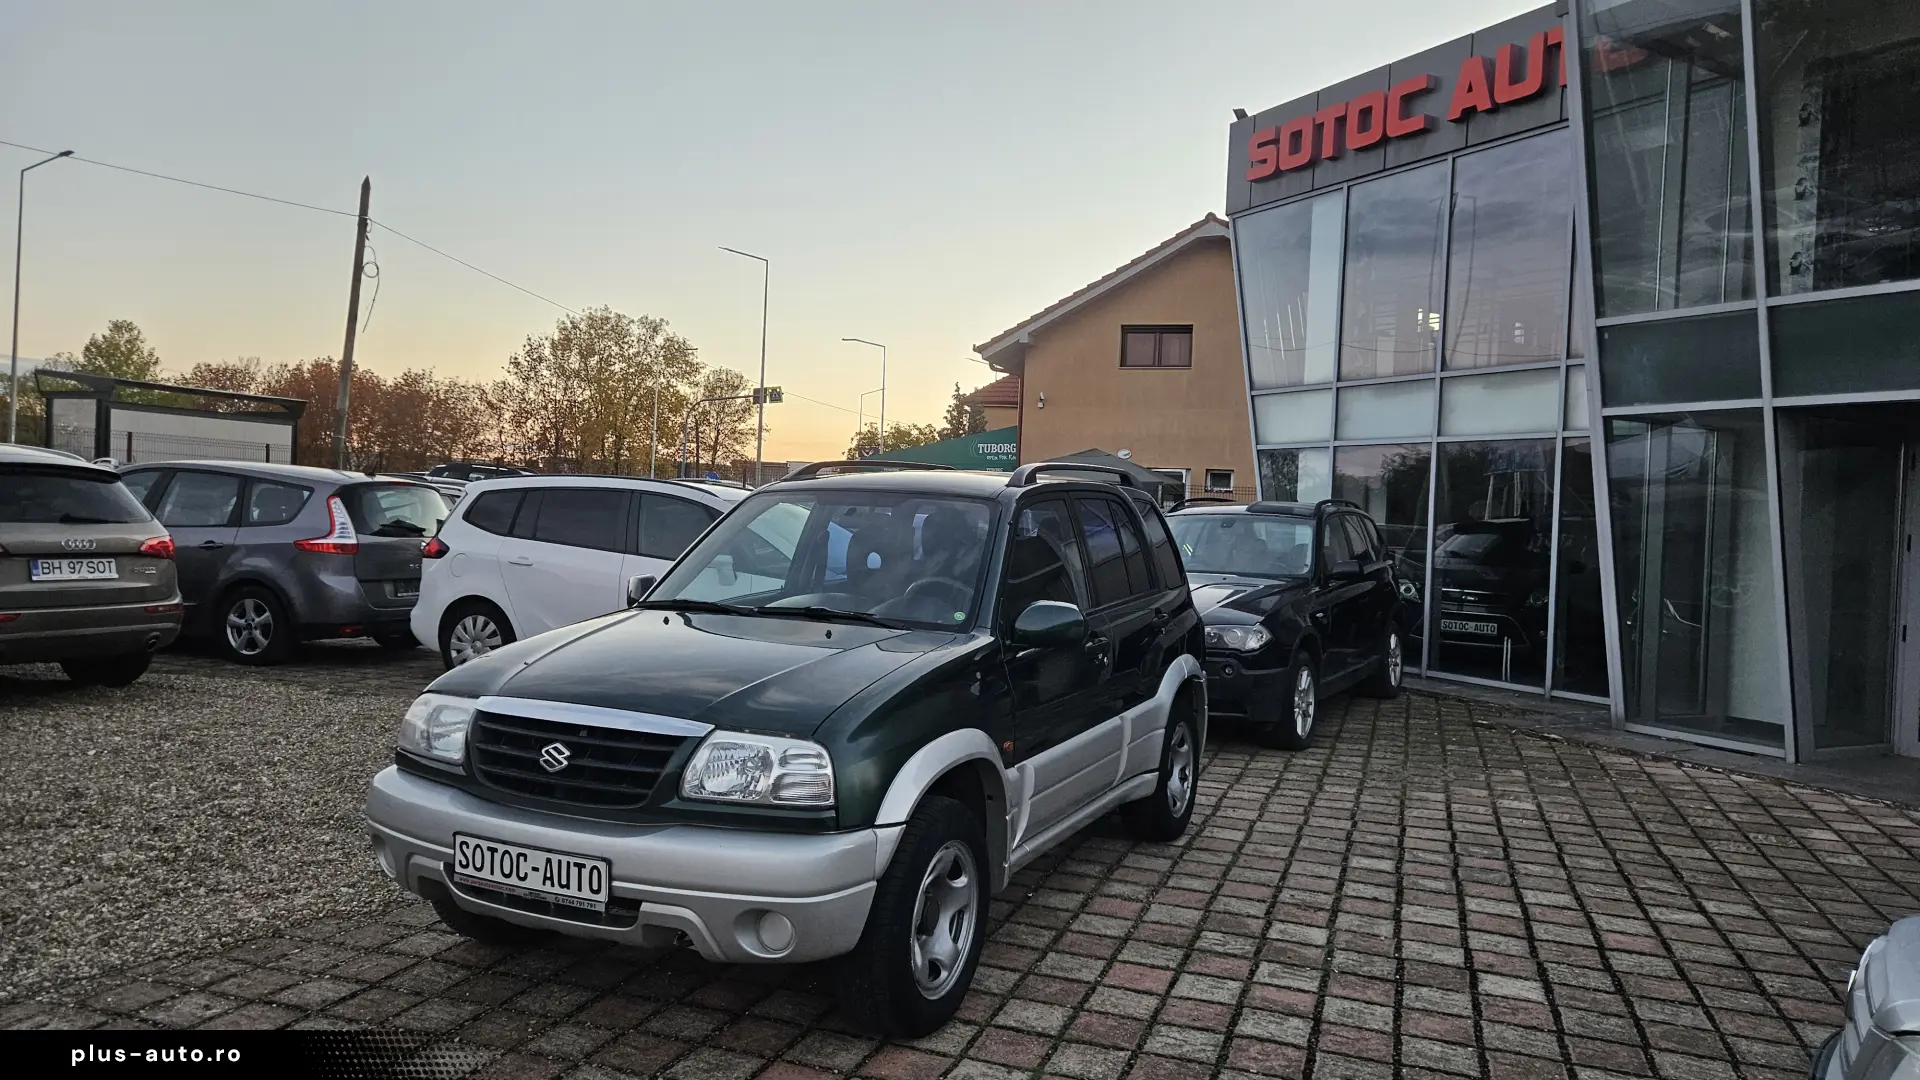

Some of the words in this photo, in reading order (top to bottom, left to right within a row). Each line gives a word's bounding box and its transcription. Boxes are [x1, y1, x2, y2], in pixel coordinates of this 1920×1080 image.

[1247, 74, 1434, 182] SOTOC
[978, 443, 1016, 453] TUBORG
[41, 561, 62, 575] BH
[67, 560, 84, 574] 97
[87, 560, 114, 574] SOT
[1442, 620, 1496, 633] SOTOC-AUTO
[458, 840, 602, 895] SOTOC-AUTO
